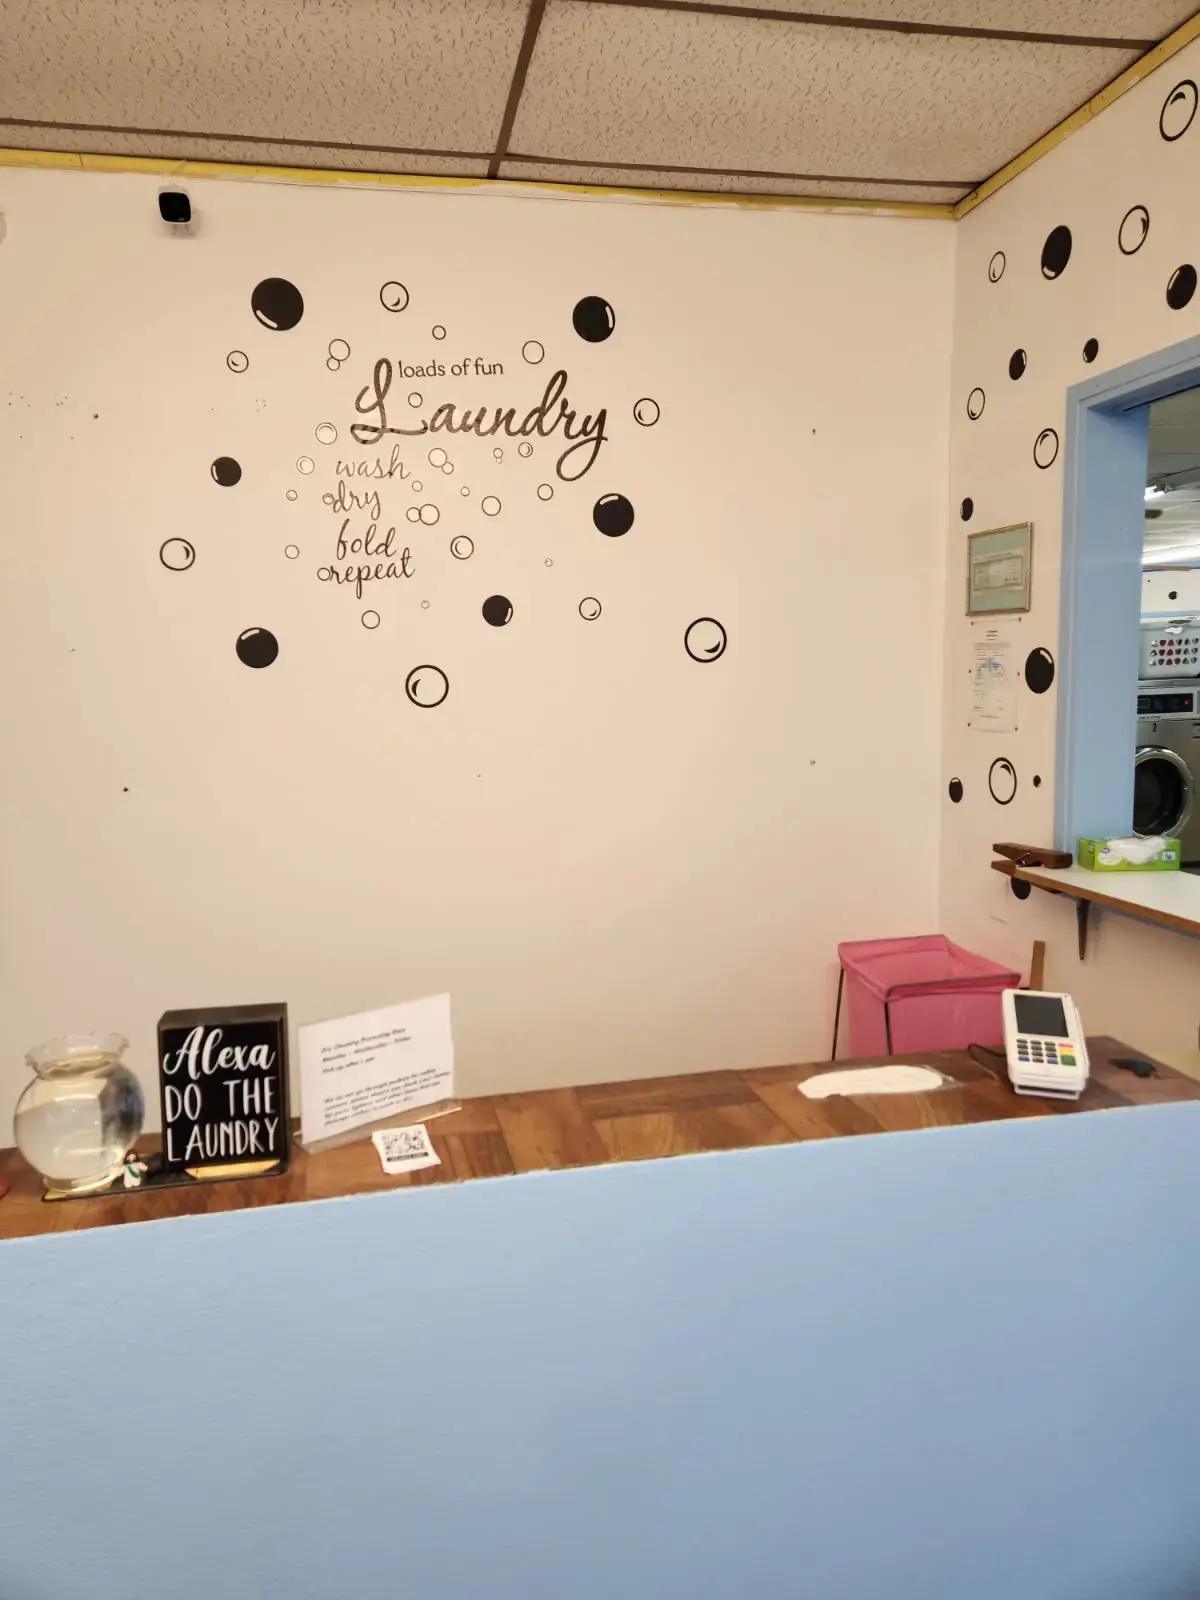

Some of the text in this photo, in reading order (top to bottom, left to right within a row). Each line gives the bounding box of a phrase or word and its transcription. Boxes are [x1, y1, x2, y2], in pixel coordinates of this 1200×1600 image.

[398, 357, 505, 378] loads of fun
[350, 357, 608, 482] Laundry
[335, 443, 411, 480] wash
[332, 479, 381, 521] dry
[336, 518, 397, 561] fold
[329, 547, 415, 600] repeat
[163, 1025, 276, 1081] Alexa
[164, 1083, 202, 1124] DO
[222, 1075, 277, 1118] THE
[166, 1116, 280, 1162] LAUNDRY
